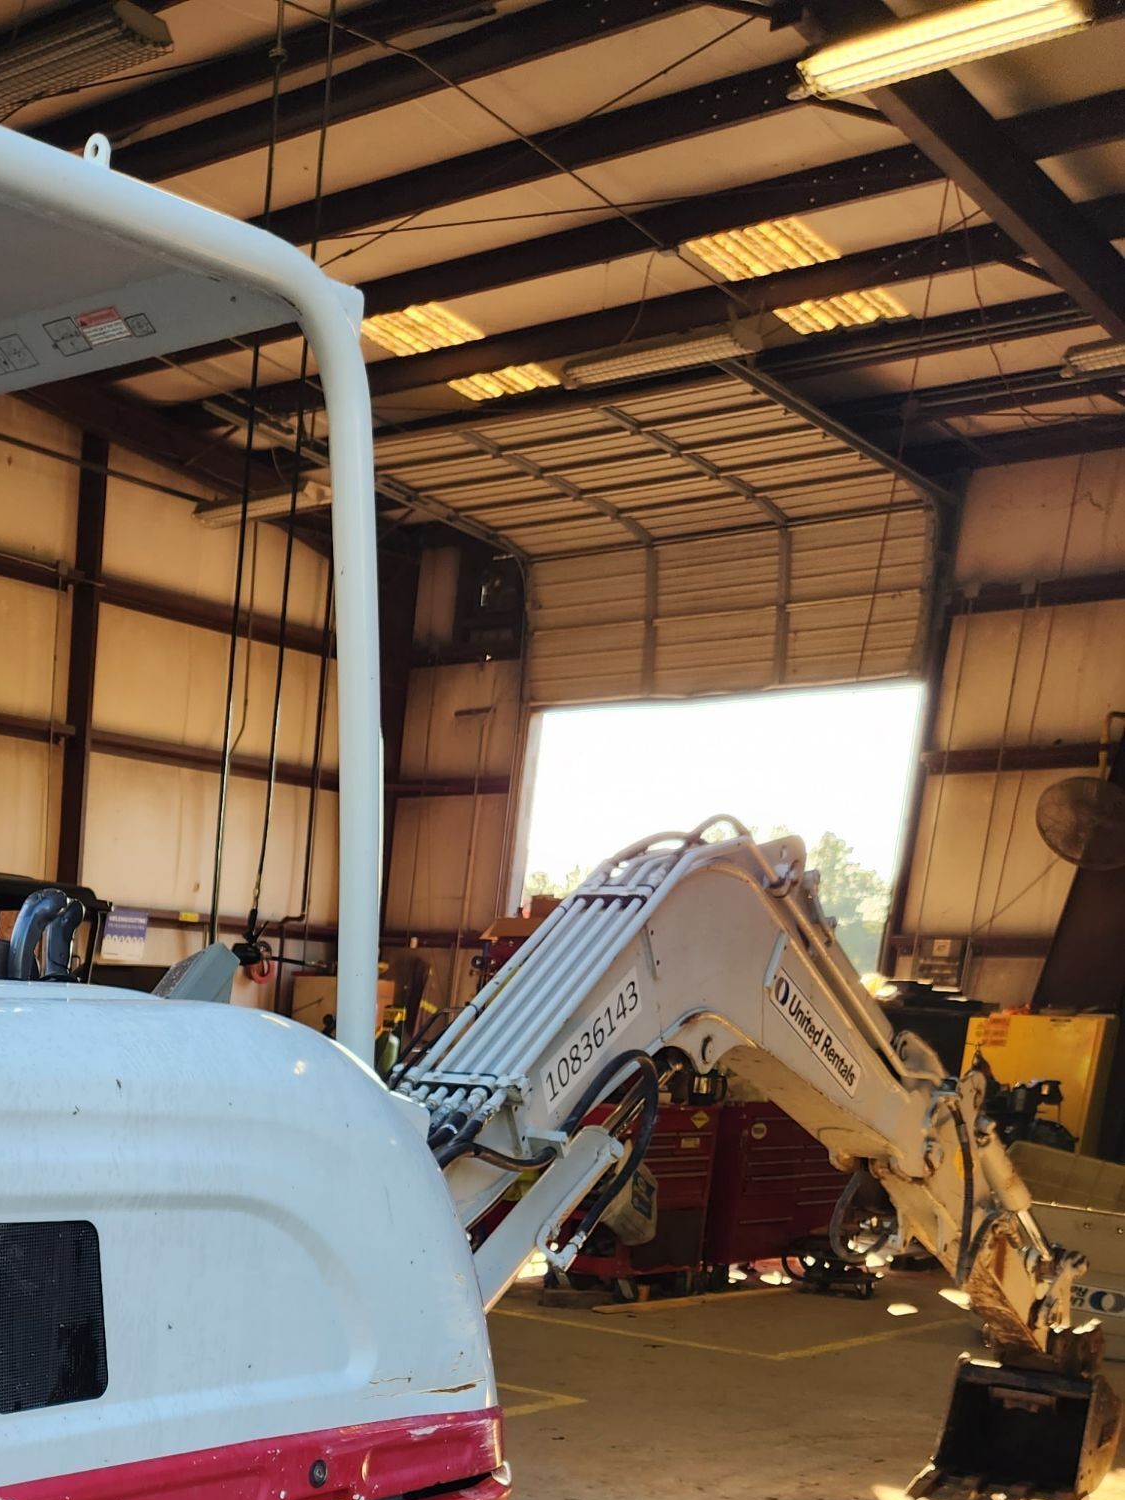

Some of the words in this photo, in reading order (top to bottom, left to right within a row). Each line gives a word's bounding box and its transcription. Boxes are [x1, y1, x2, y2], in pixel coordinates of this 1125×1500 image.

[546, 981, 639, 1102] 10836143
[788, 994, 824, 1047] United
[820, 1034, 857, 1087] Rentals
